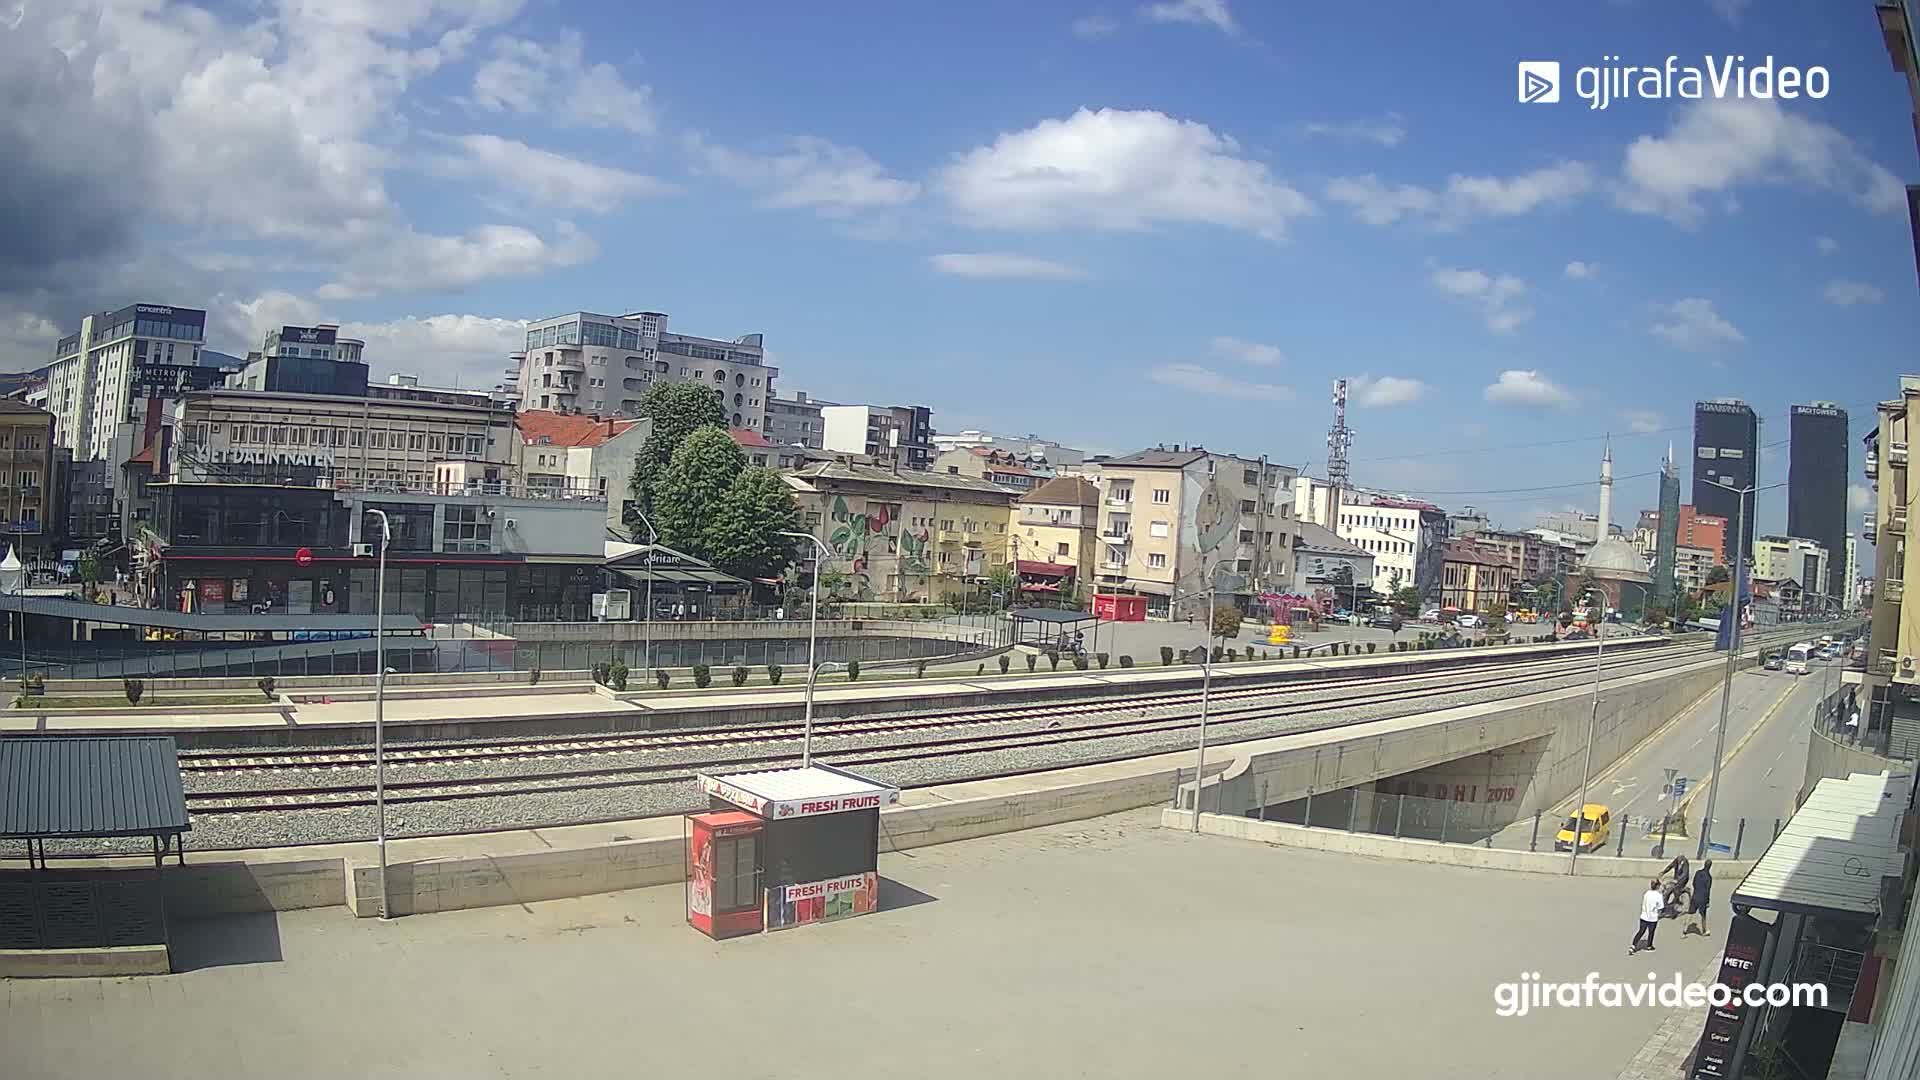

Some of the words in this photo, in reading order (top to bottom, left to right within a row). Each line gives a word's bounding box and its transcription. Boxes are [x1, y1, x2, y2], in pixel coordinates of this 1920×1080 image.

[801, 801, 838, 814] FRESH
[842, 796, 880, 809] FRUITS
[789, 886, 823, 898] FRESH
[827, 878, 862, 892] FRUITS
